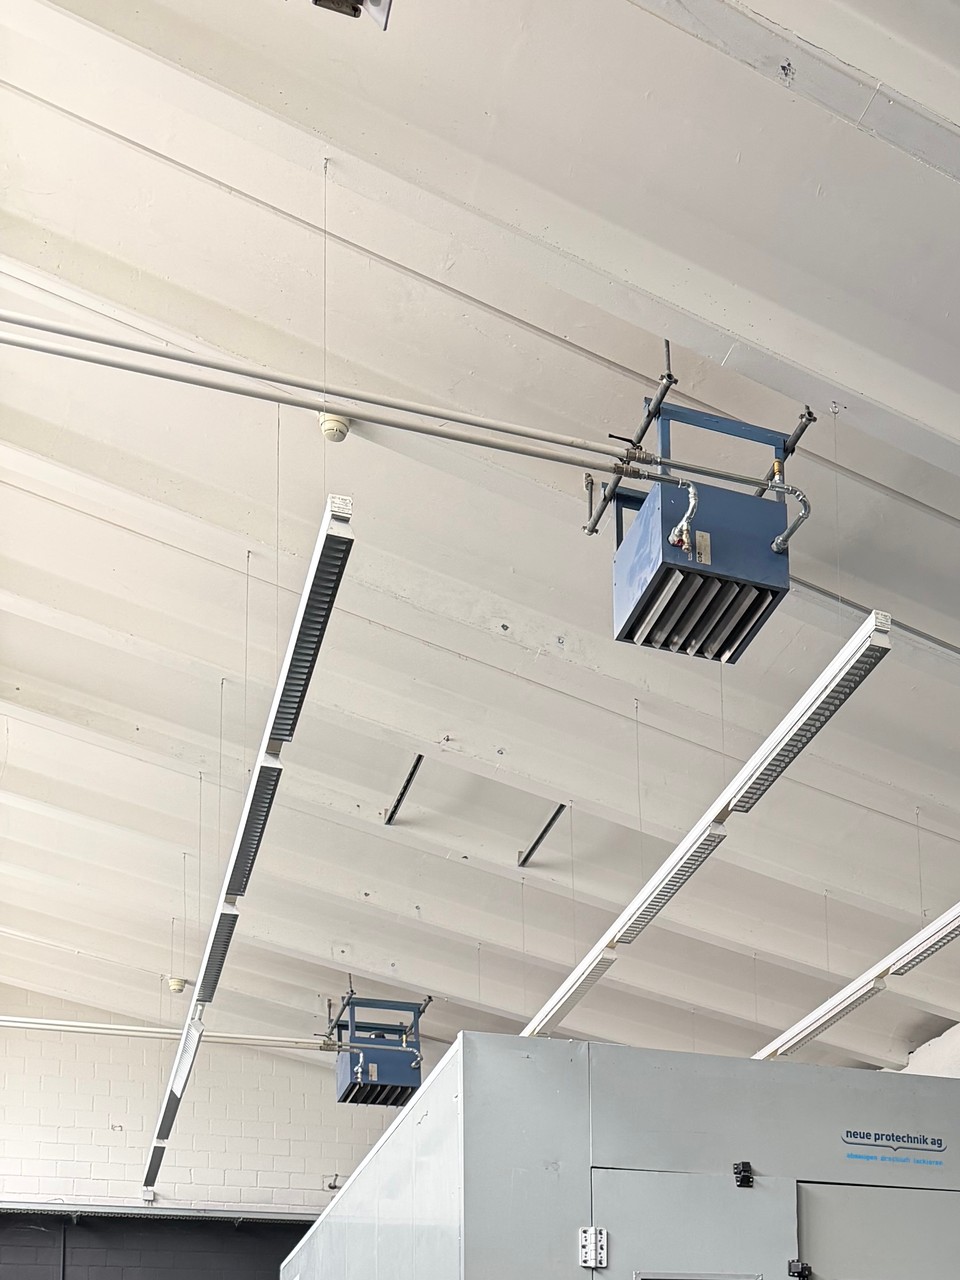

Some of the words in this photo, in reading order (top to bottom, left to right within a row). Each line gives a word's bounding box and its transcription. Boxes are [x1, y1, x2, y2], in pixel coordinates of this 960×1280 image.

[846, 1130, 872, 1140] neue
[874, 1132, 928, 1145] protechnik
[931, 1138, 943, 1148] ag
